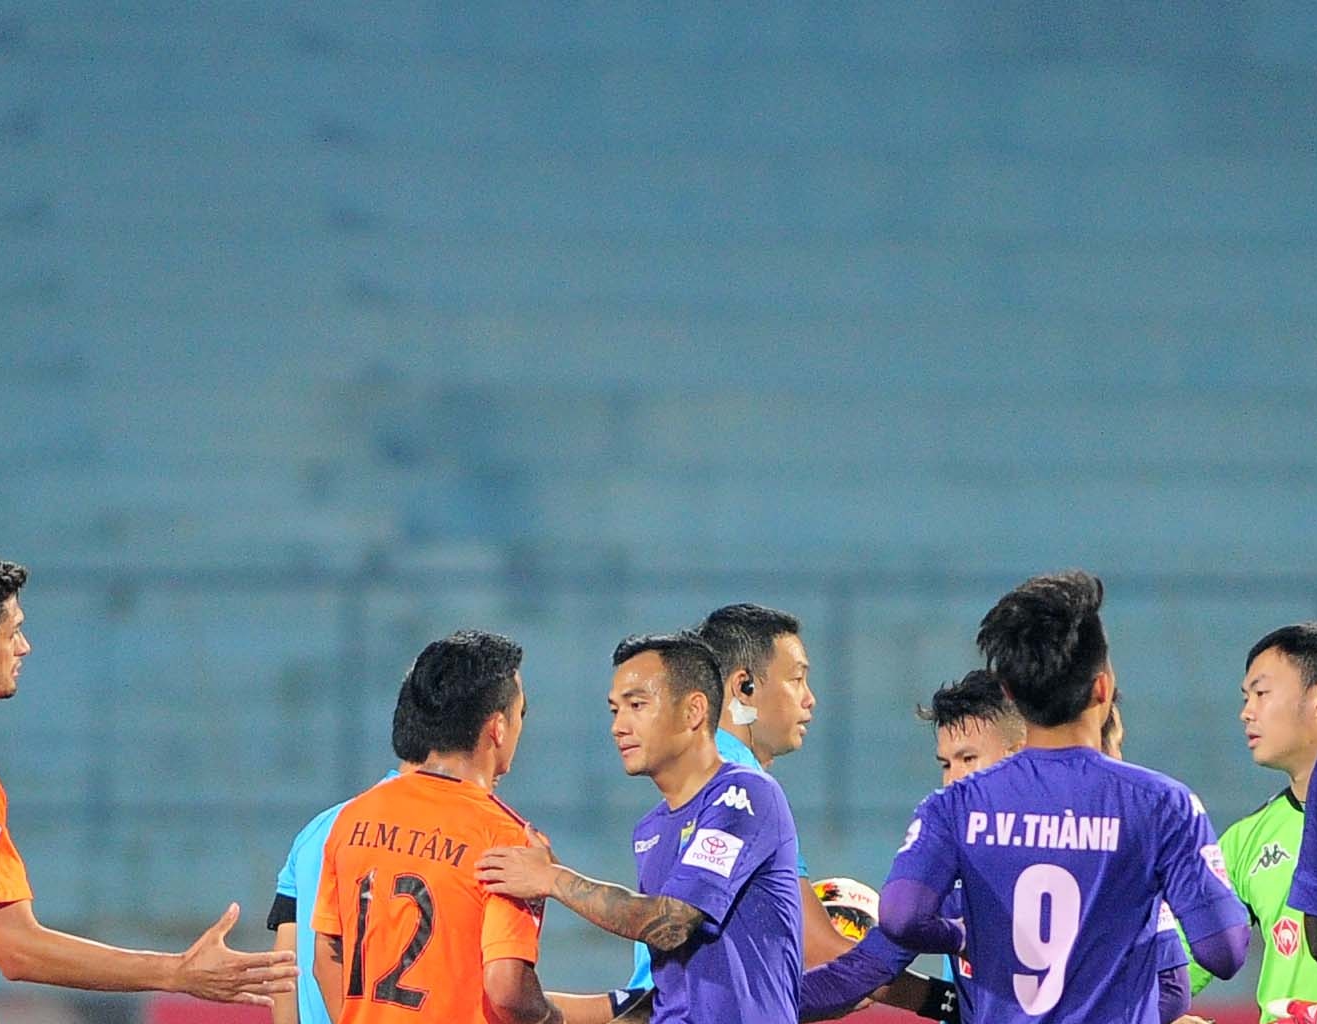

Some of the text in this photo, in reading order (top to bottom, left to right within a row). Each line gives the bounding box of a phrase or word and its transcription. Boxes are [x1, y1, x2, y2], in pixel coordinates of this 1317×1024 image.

[348, 822, 468, 868] H.M.TÂM
[966, 809, 1121, 851] P.V.THÀNH
[692, 851, 726, 868] TOYOTA
[346, 868, 435, 1011] 12
[1013, 863, 1081, 1016] 9
